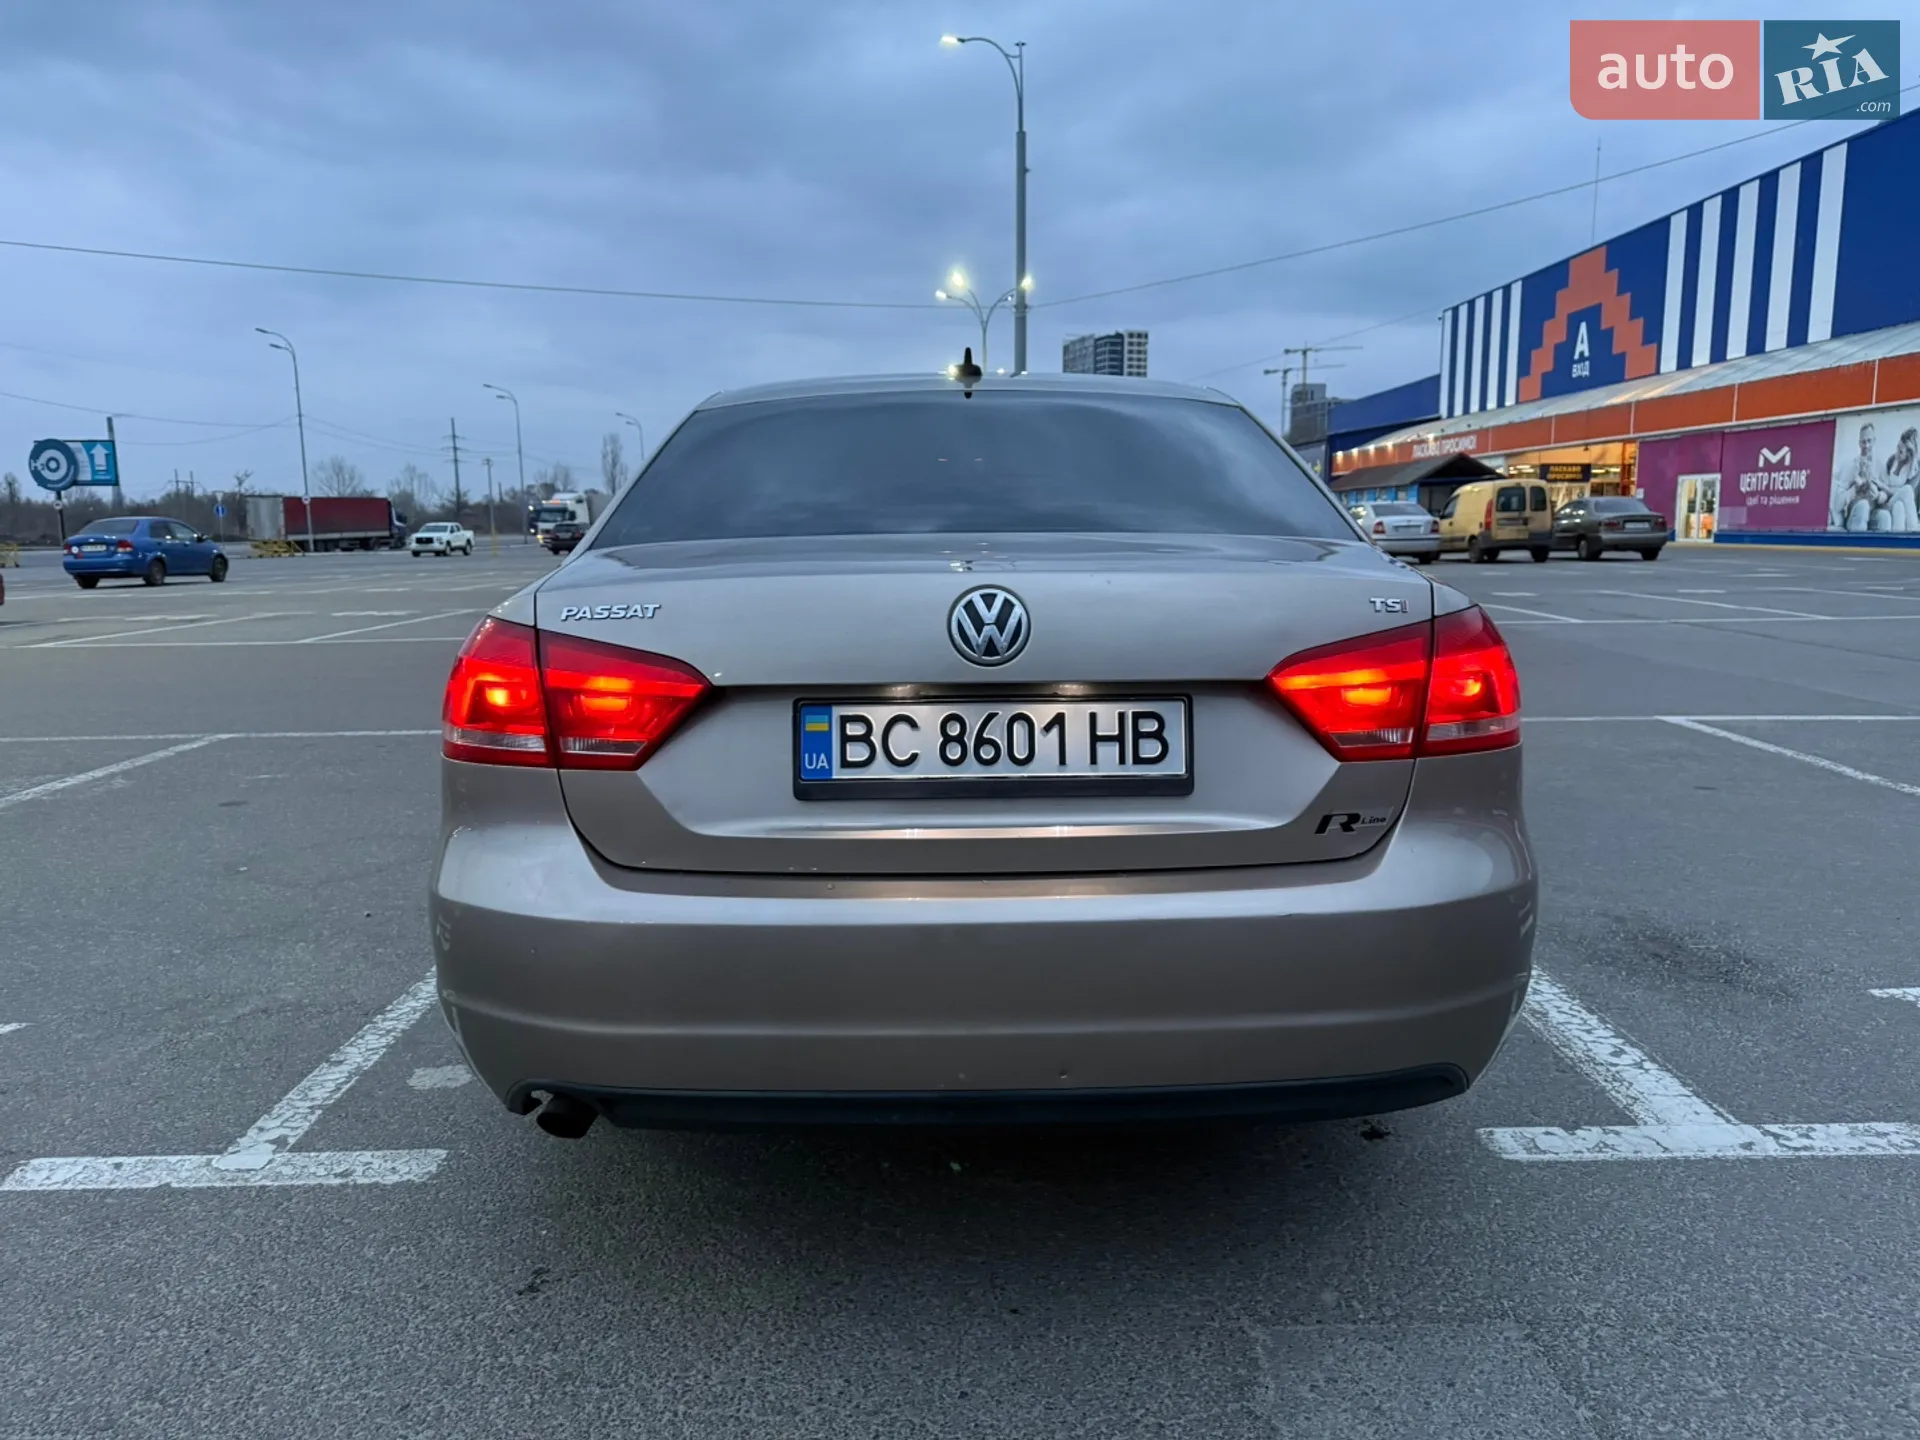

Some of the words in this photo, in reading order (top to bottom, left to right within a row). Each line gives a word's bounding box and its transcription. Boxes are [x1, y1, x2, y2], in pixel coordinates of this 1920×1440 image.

[1573, 321, 1590, 360] А
[1739, 472, 1769, 494] ЦЕНТР
[1769, 469, 1807, 491] МЕБЛІВ
[560, 604, 661, 622] PASSAT
[839, 713, 921, 768] BC
[938, 711, 1068, 767] 8601
[1088, 711, 1170, 765] HB
[805, 753, 829, 769] UA
[1314, 812, 1361, 834] R
